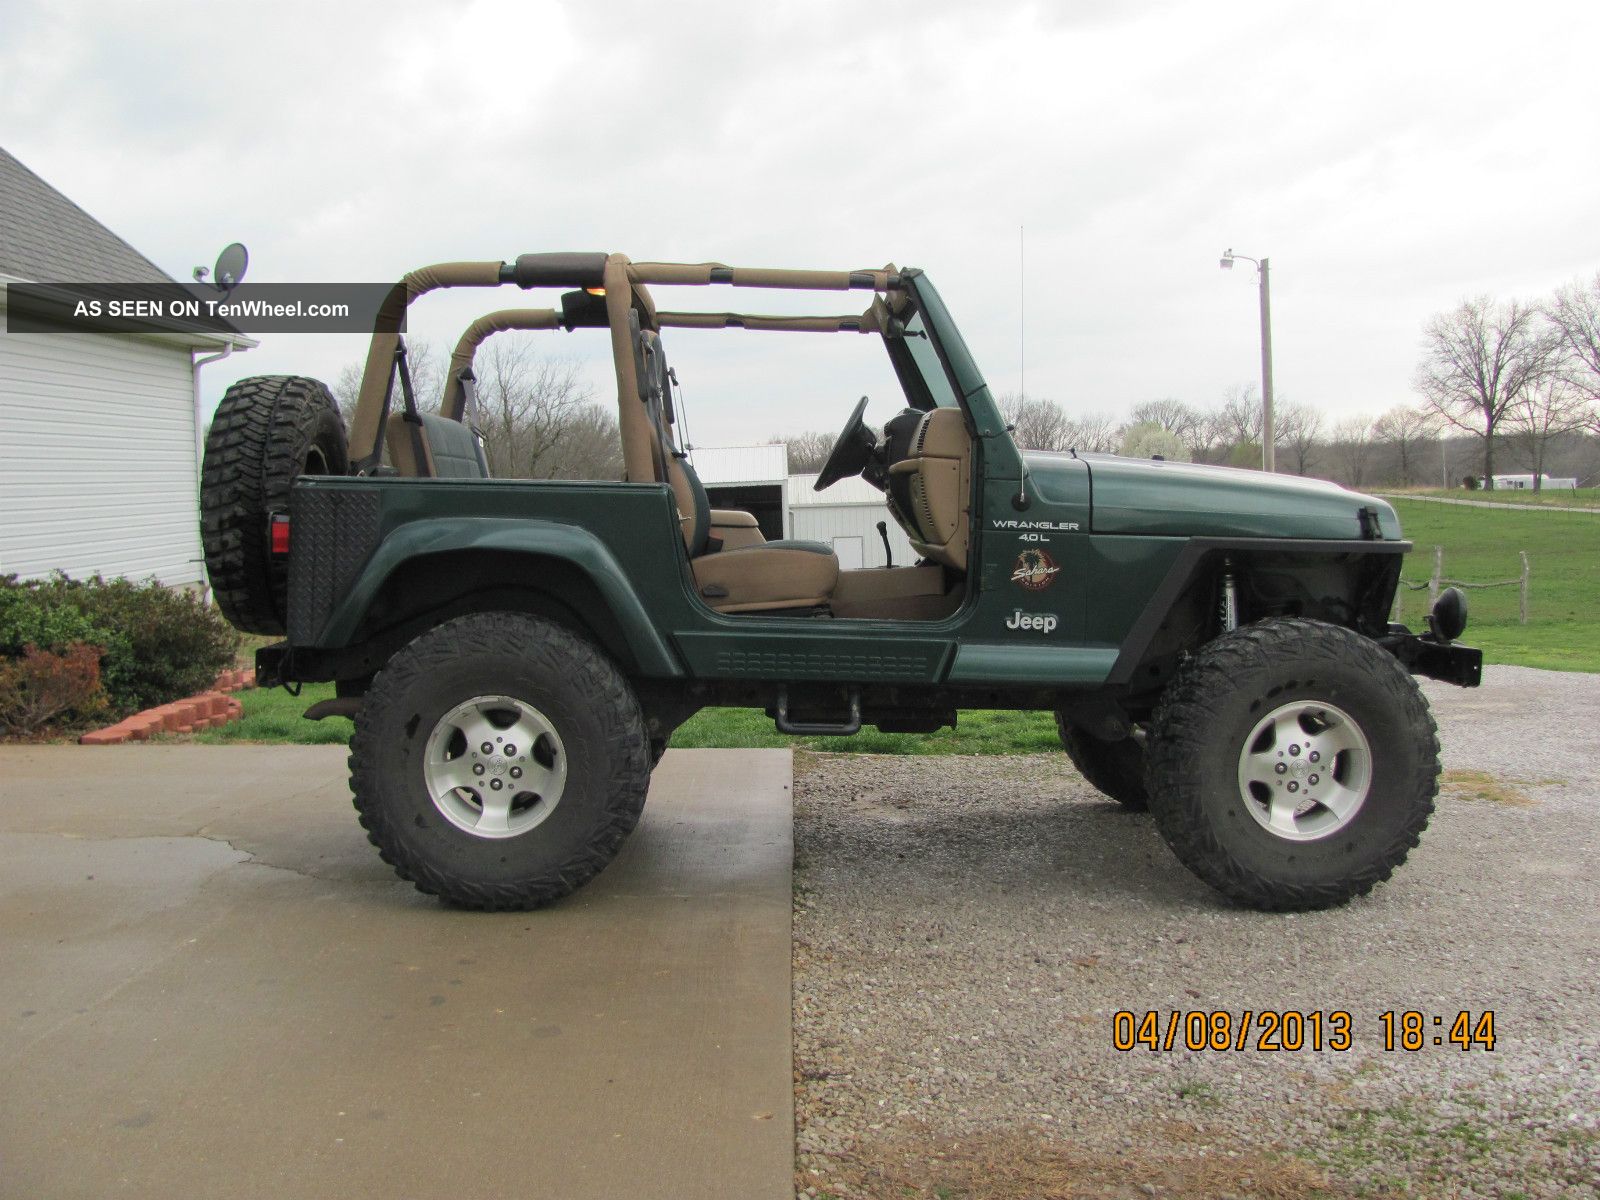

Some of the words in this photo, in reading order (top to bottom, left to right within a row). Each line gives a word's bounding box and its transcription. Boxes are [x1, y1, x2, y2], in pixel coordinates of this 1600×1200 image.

[992, 520, 1079, 531] WRANGLER
[1010, 565, 1060, 581] Sahara
[1006, 611, 1057, 634] Jeep
